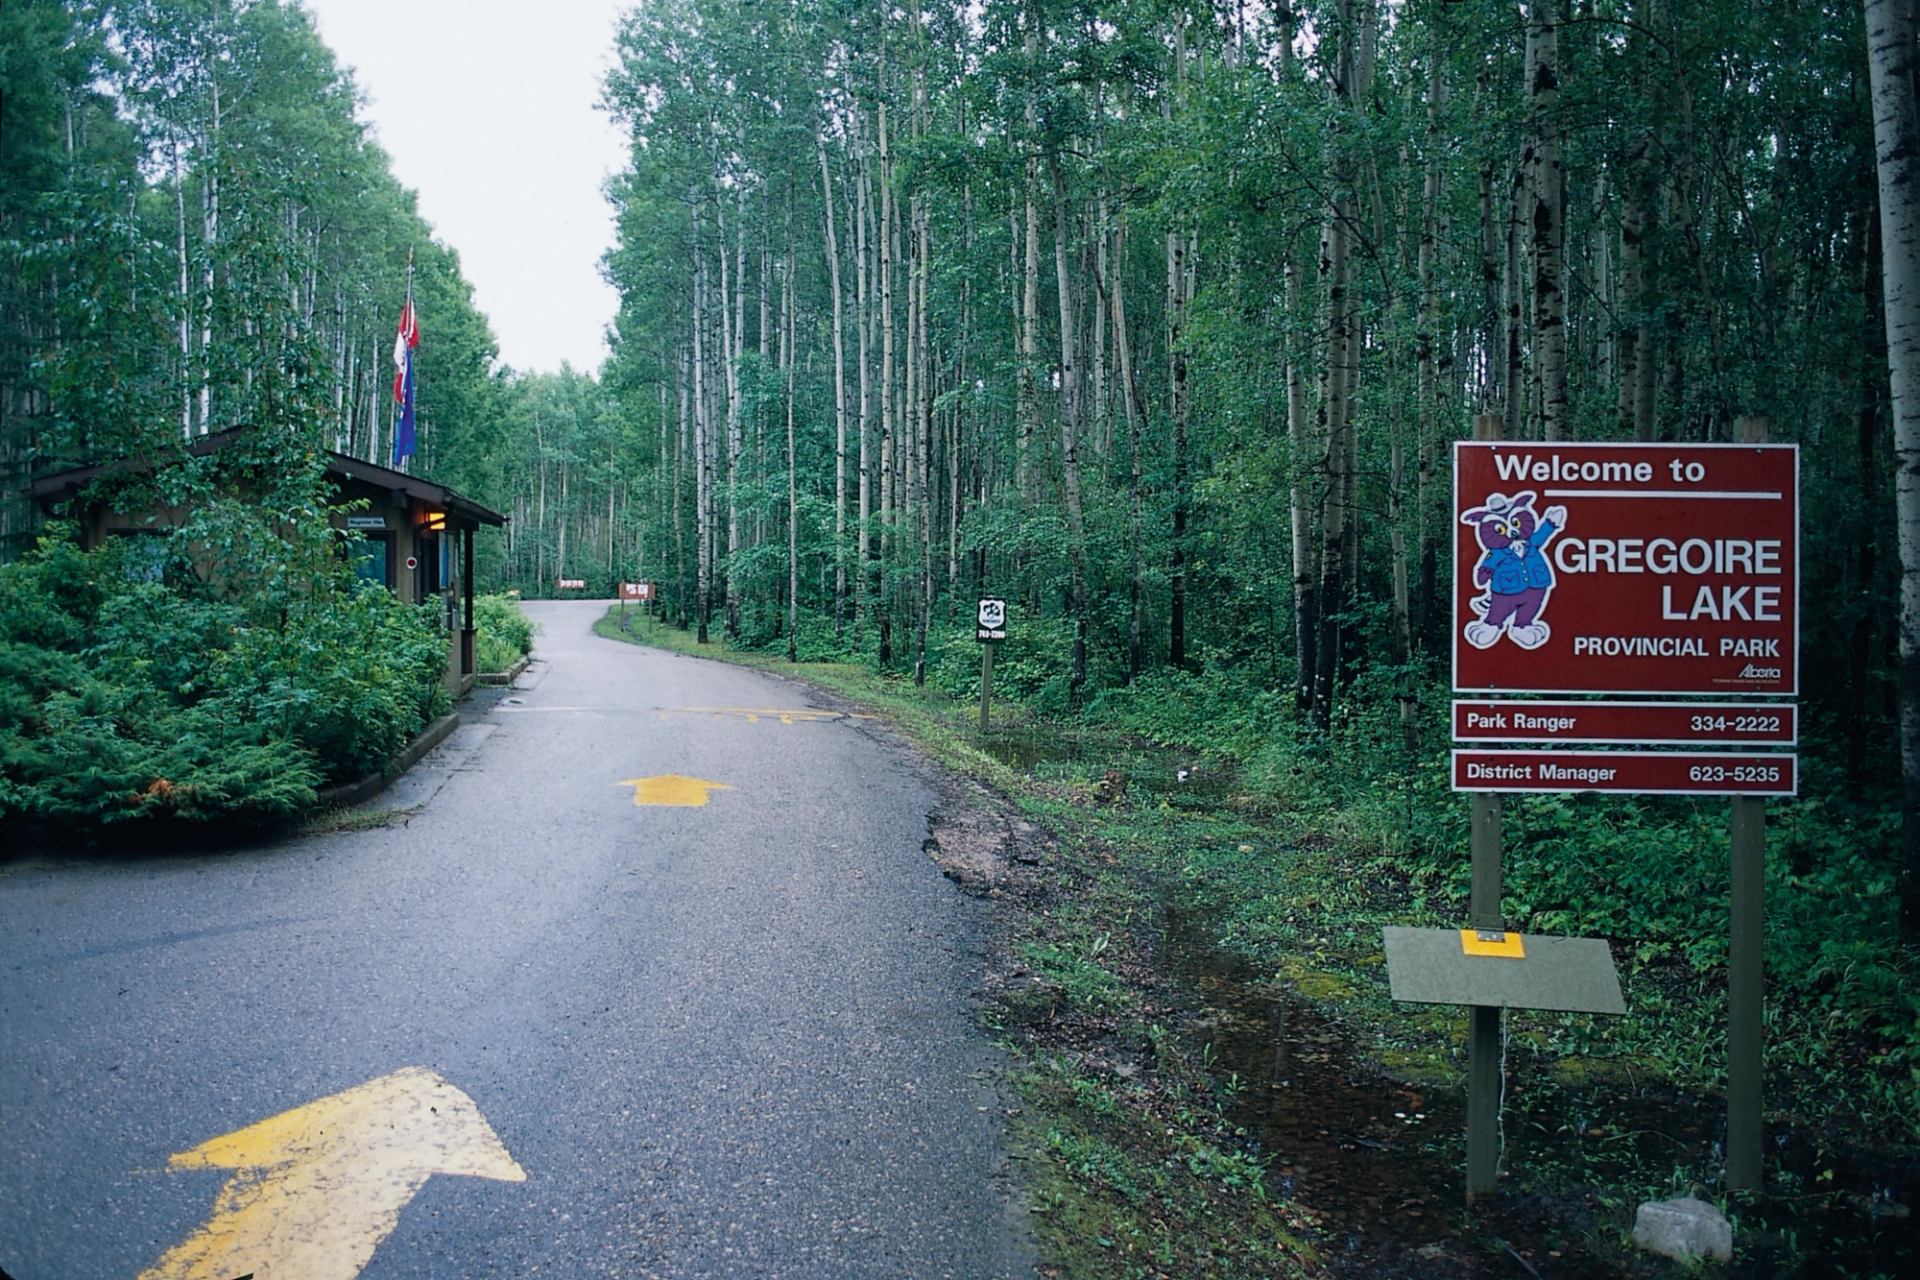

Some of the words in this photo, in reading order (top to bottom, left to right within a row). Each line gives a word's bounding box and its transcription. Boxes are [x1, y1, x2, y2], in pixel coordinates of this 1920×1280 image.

[1493, 454, 1653, 482] Welcome
[1669, 458, 1705, 482] to
[1554, 537, 1782, 575] GREGOIRE
[1662, 585, 1781, 621] LAKE
[1574, 636, 1709, 657] PROVINCIAL
[1720, 638, 1780, 657] PARK
[1738, 663, 1781, 678] Alberta
[1467, 712, 1507, 729] Park
[1514, 713, 1577, 733] Ranger
[1690, 715, 1780, 732] 334-2222
[1467, 763, 1532, 779] District
[1539, 763, 1617, 784] Manager
[1689, 766, 1780, 782] 623-5235
